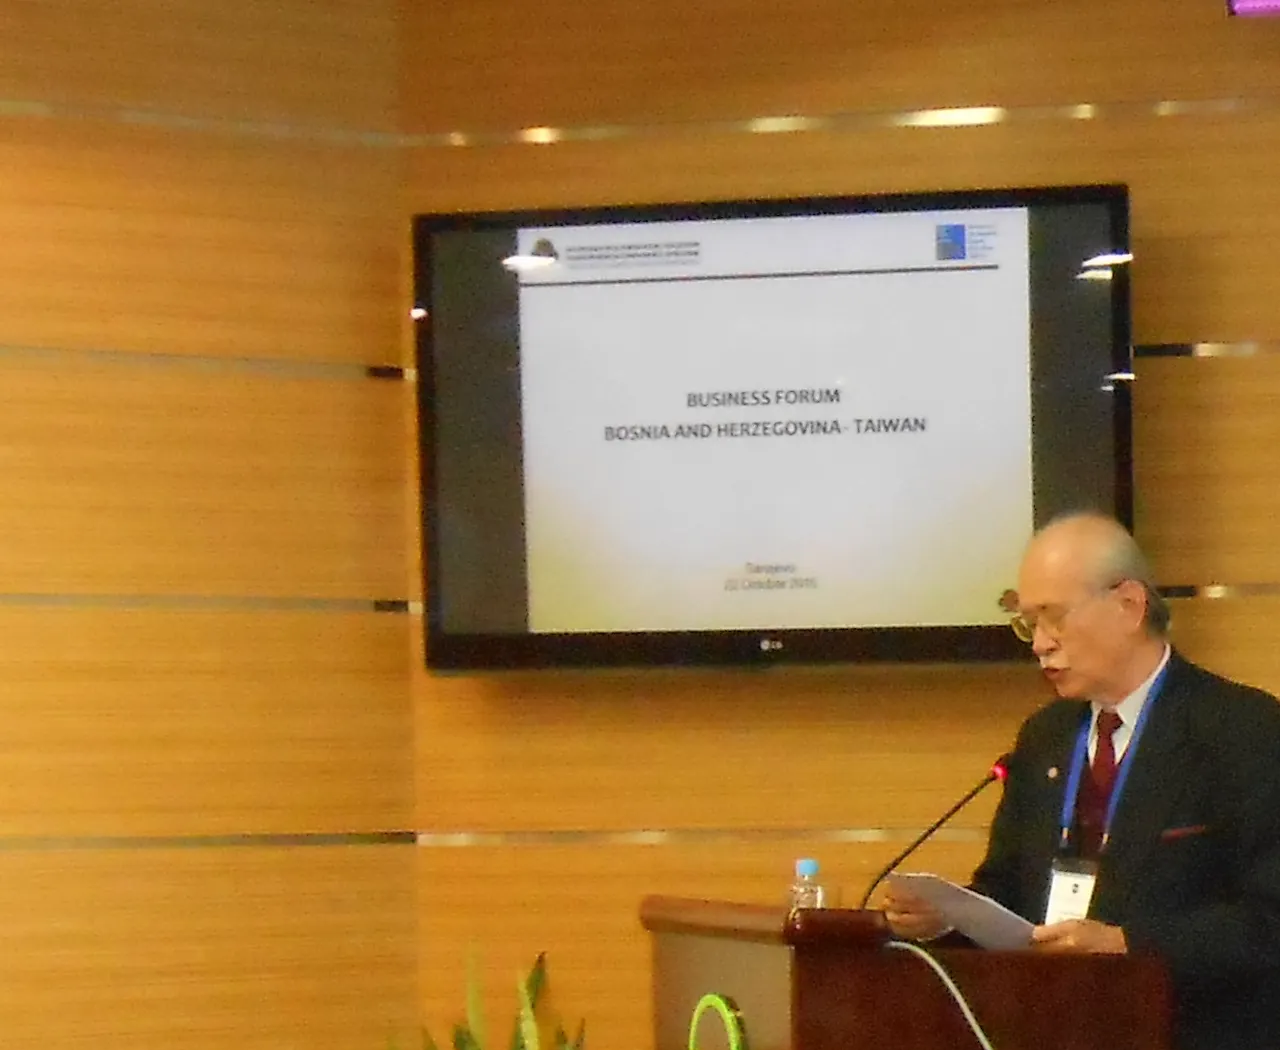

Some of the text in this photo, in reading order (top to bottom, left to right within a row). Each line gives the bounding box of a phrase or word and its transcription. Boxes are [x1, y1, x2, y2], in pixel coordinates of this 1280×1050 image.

[686, 388, 841, 407] BUSINESS FORUM
[604, 424, 670, 441] BOSNIA
[674, 423, 712, 439] AND
[717, 420, 841, 438] HERZEGOVINA
[854, 417, 926, 434] TAIWAN
